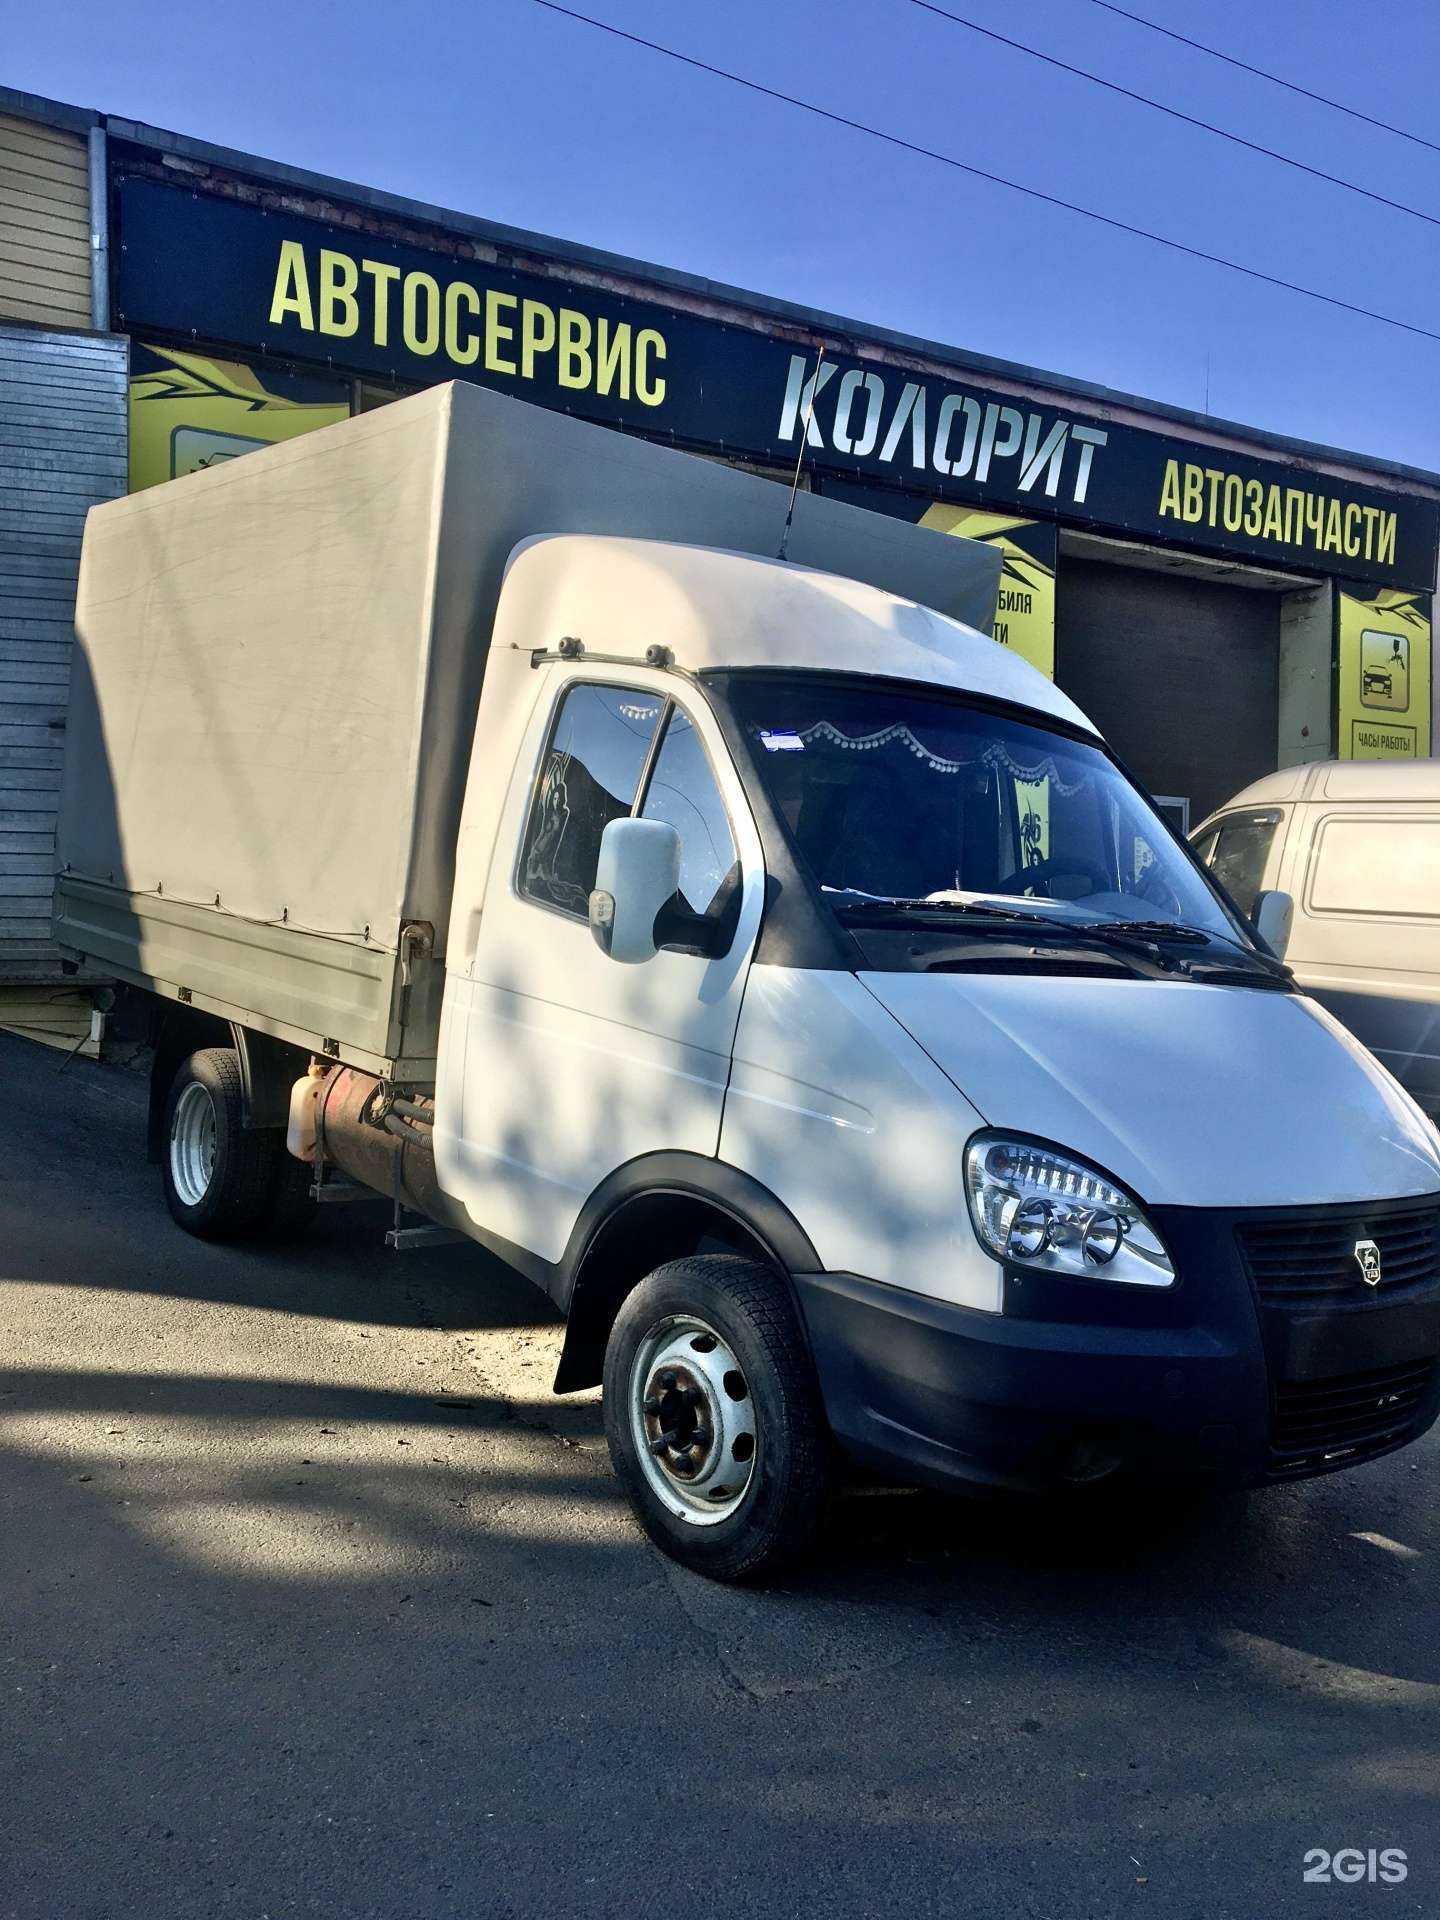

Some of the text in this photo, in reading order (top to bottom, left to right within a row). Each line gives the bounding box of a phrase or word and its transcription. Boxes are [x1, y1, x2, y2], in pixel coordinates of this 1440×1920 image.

[269, 239, 668, 407] АВТОСЕРВИС
[777, 354, 1108, 503] КОЛОРИТ
[1158, 458, 1398, 565] АВТОЗАПЧАСТИ
[1358, 732, 1411, 751] ЧАСЫ РАБОТЫ
